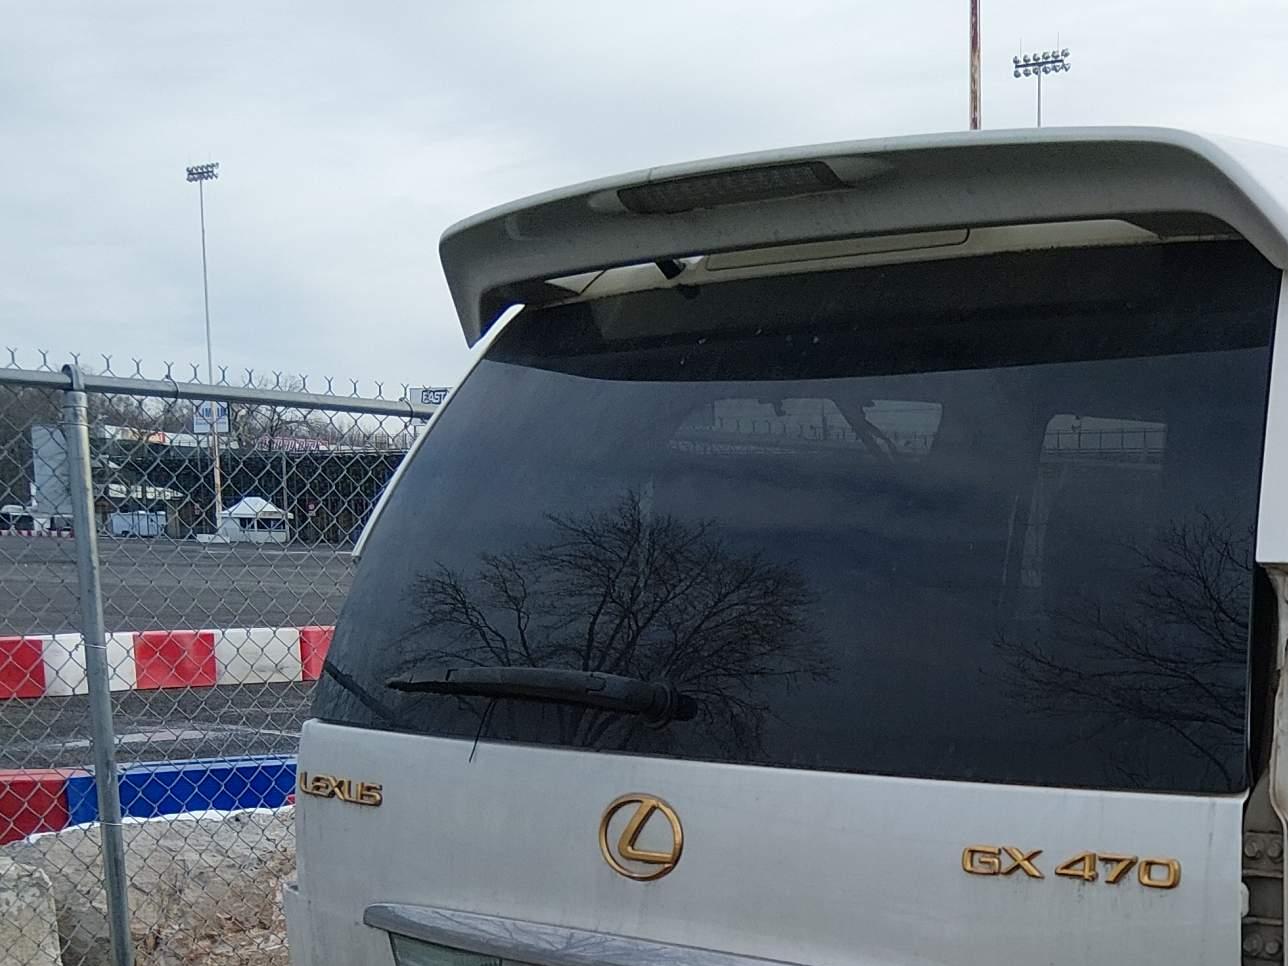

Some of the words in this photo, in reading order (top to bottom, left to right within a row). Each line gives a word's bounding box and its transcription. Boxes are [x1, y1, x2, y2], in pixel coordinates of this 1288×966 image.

[300, 772, 383, 807] LEXUS
[962, 847, 1044, 879] GX
[1055, 851, 1181, 889] 470
